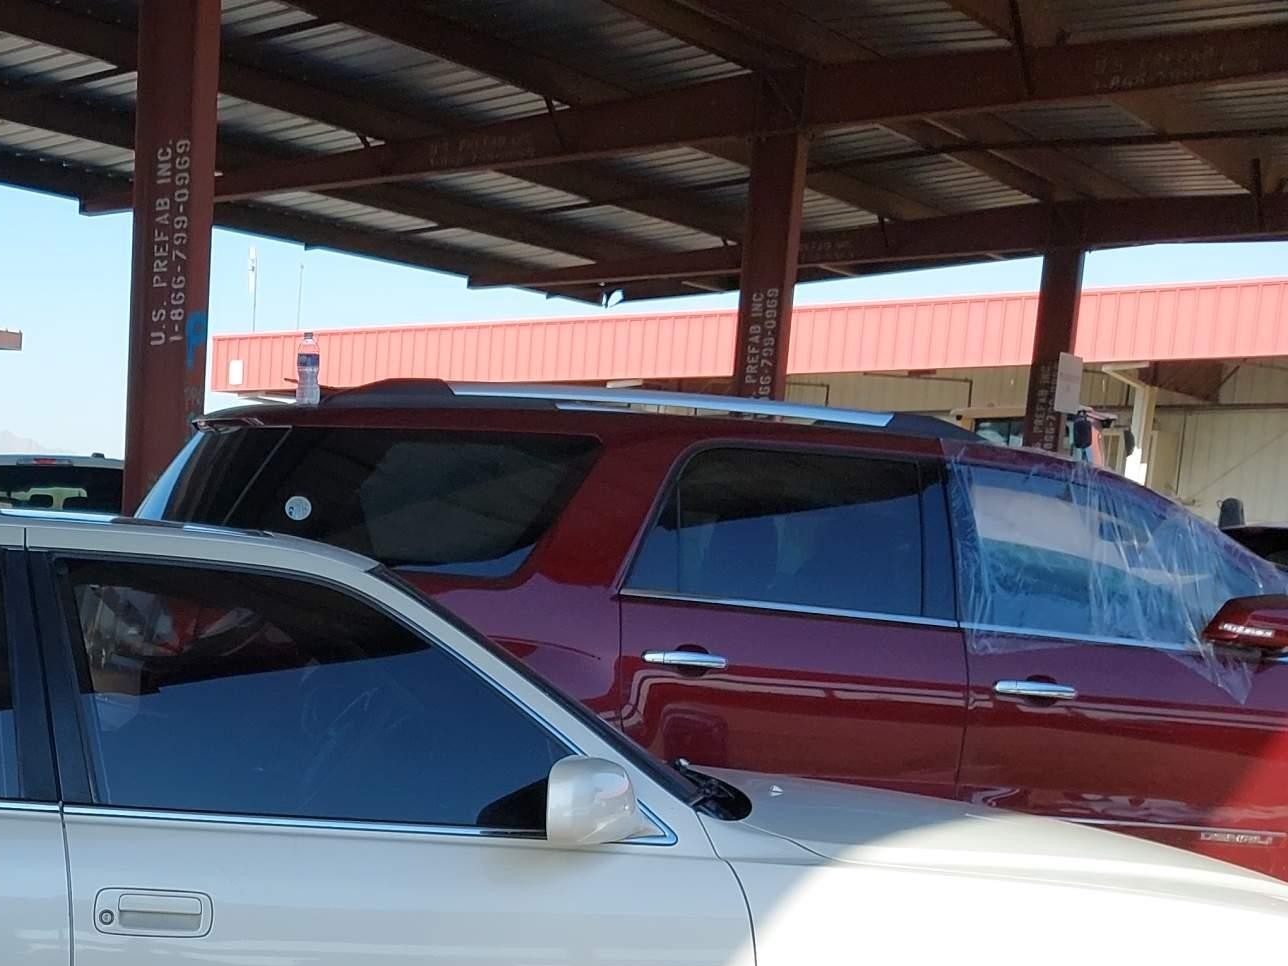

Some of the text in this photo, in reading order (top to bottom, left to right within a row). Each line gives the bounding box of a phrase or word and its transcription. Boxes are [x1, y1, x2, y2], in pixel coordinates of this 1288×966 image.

[150, 139, 173, 346] U.S. PREFAB INC.
[169, 139, 191, 343] 1-866-799-0969
[744, 324, 762, 384] PREFAB
